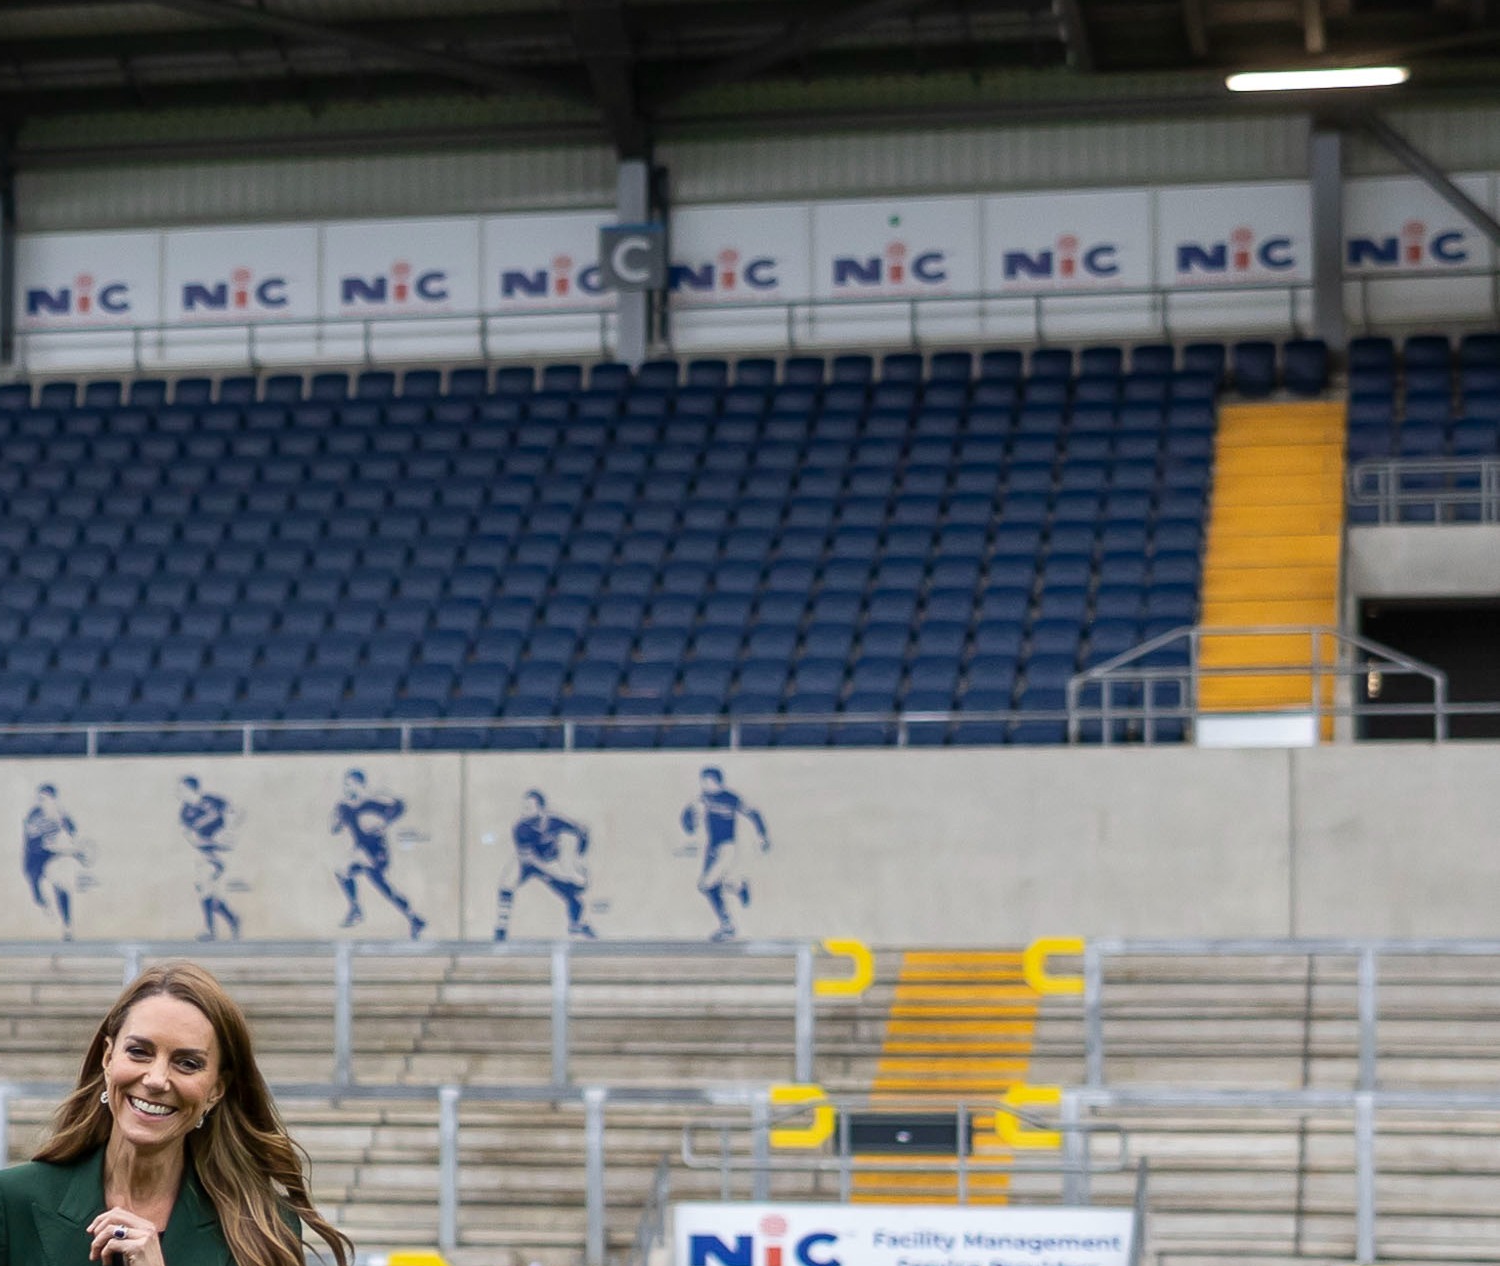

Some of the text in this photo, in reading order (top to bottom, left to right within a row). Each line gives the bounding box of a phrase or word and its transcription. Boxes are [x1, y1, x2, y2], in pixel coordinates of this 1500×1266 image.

[611, 237, 651, 283] C
[873, 1231, 1121, 1254] Facility Management
